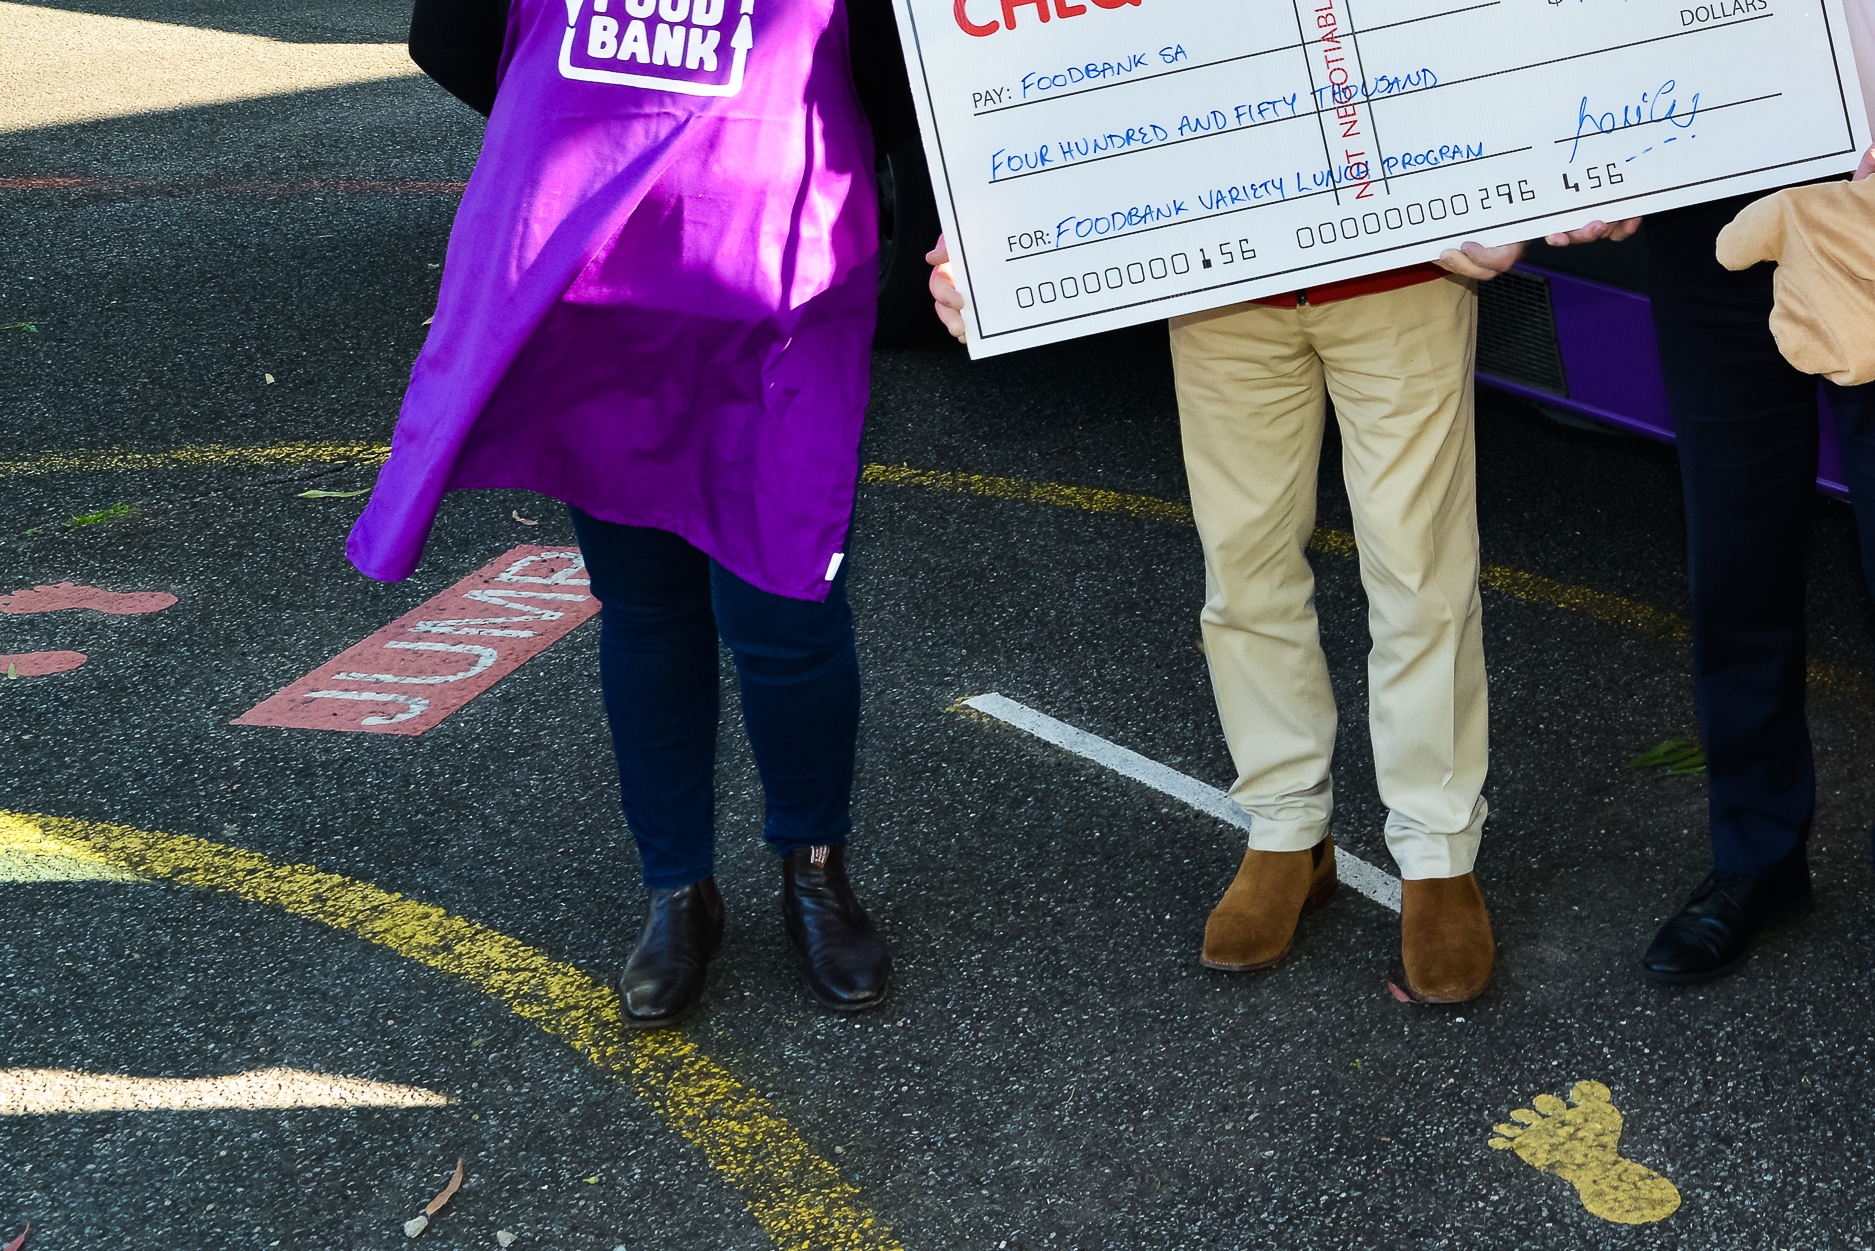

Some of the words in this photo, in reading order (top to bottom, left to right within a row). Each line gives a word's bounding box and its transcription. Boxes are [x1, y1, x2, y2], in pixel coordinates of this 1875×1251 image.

[587, 15, 721, 72] BANK
[972, 87, 1012, 109] PAY:
[1020, 52, 1149, 99] FOODBANK
[1158, 44, 1188, 64] SA
[991, 144, 1054, 181] FOUR
[1058, 123, 1168, 162] HUNDRED
[1177, 109, 1227, 137] AND
[1234, 93, 1297, 126] FIFTY
[1310, 67, 1438, 109] THOUSAND
[1007, 229, 1052, 252] FOR:
[1055, 199, 1190, 248] FOODBANK
[1198, 177, 1286, 211] VARIETY
[1296, 160, 1371, 193] LUNCH
[1382, 142, 1484, 175] PROGRAM
[1345, 149, 1374, 200] NOT
[1562, 162, 1625, 193] 456
[302, 550, 592, 727] JUMP
